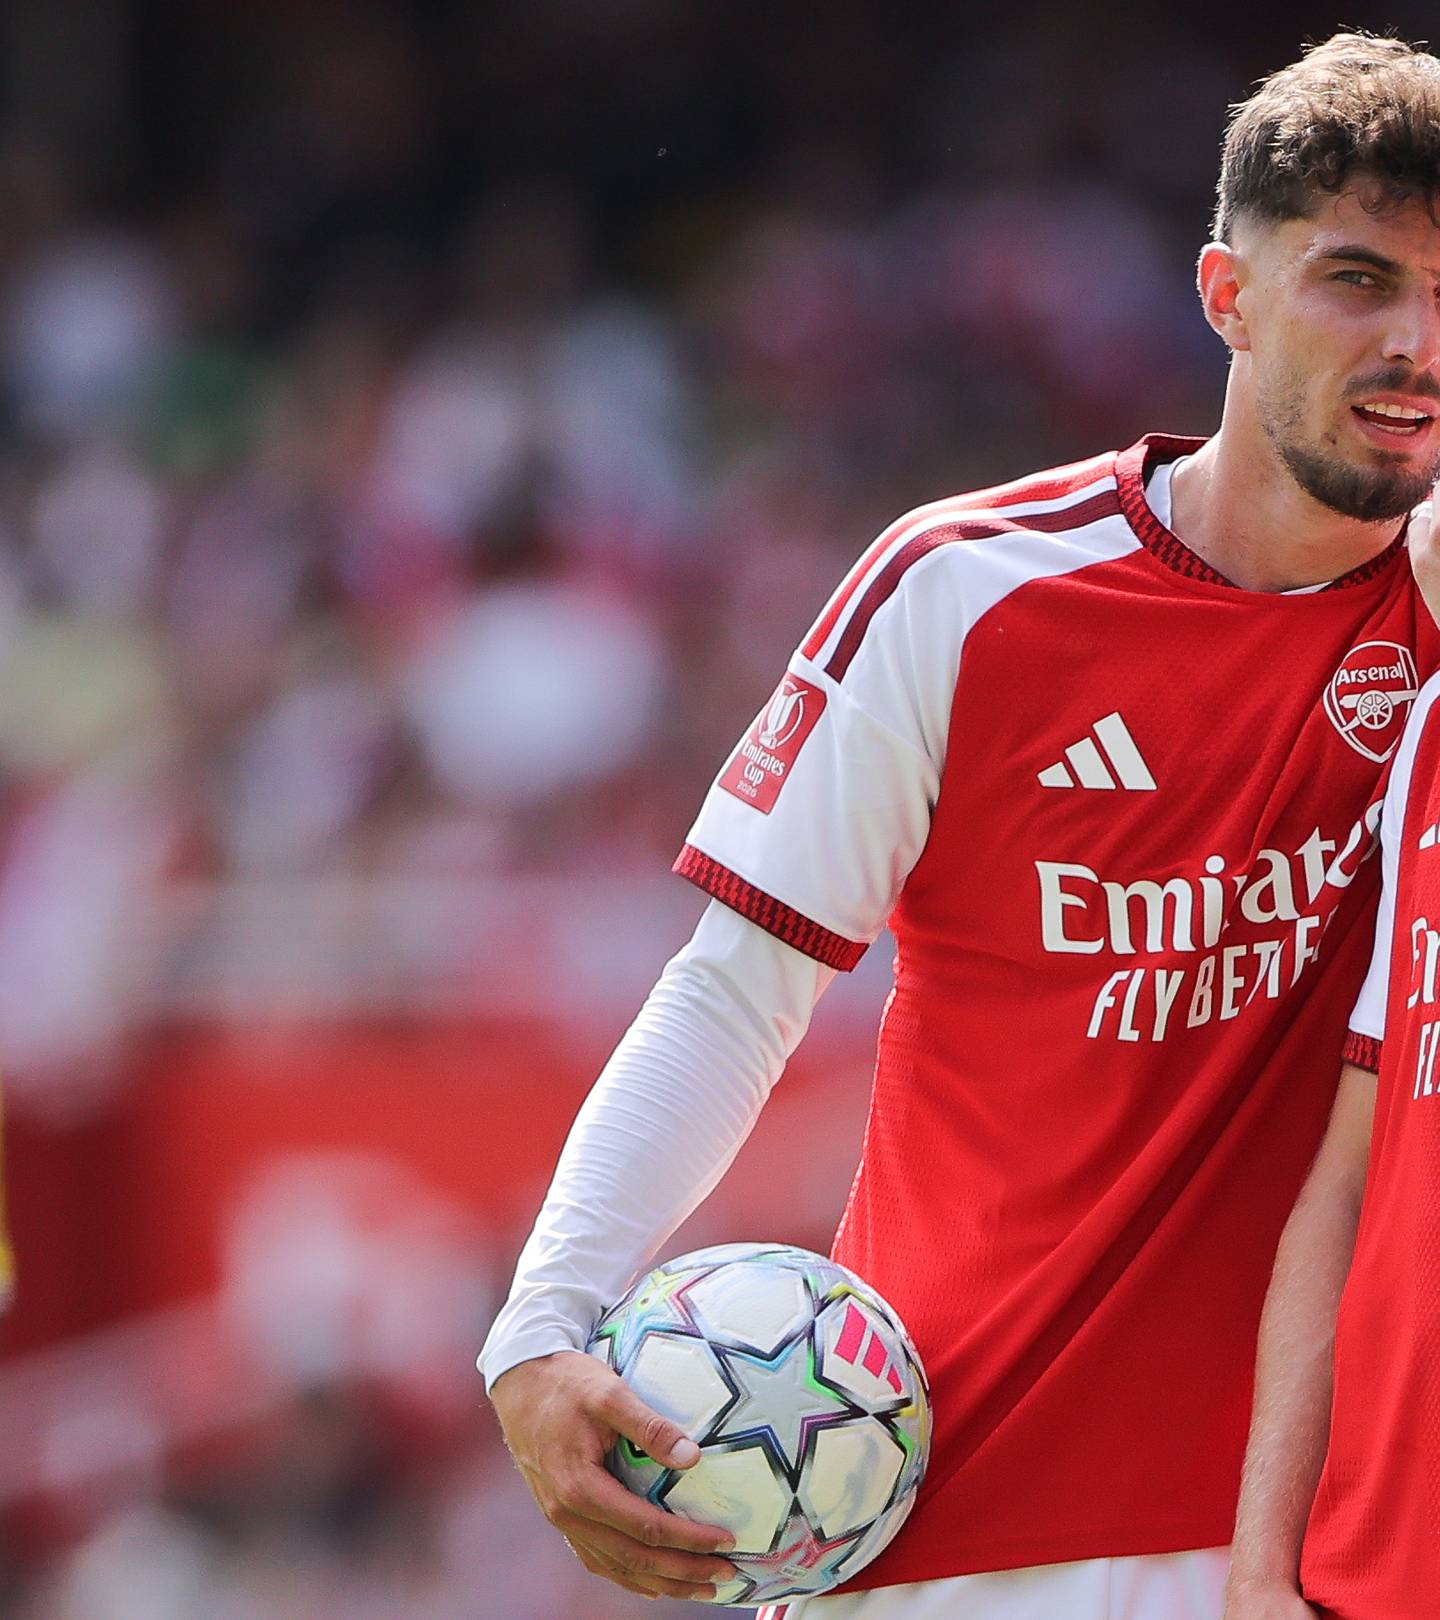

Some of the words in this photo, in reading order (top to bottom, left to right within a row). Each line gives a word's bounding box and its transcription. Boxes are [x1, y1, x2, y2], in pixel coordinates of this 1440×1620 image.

[1336, 661, 1404, 686] Arsenal
[741, 738, 786, 777] Emirates
[743, 761, 765, 786] Cup
[1034, 799, 1384, 956] Emiate
[1086, 968, 1185, 1043] FLY
[1186, 904, 1340, 1029] BETE
